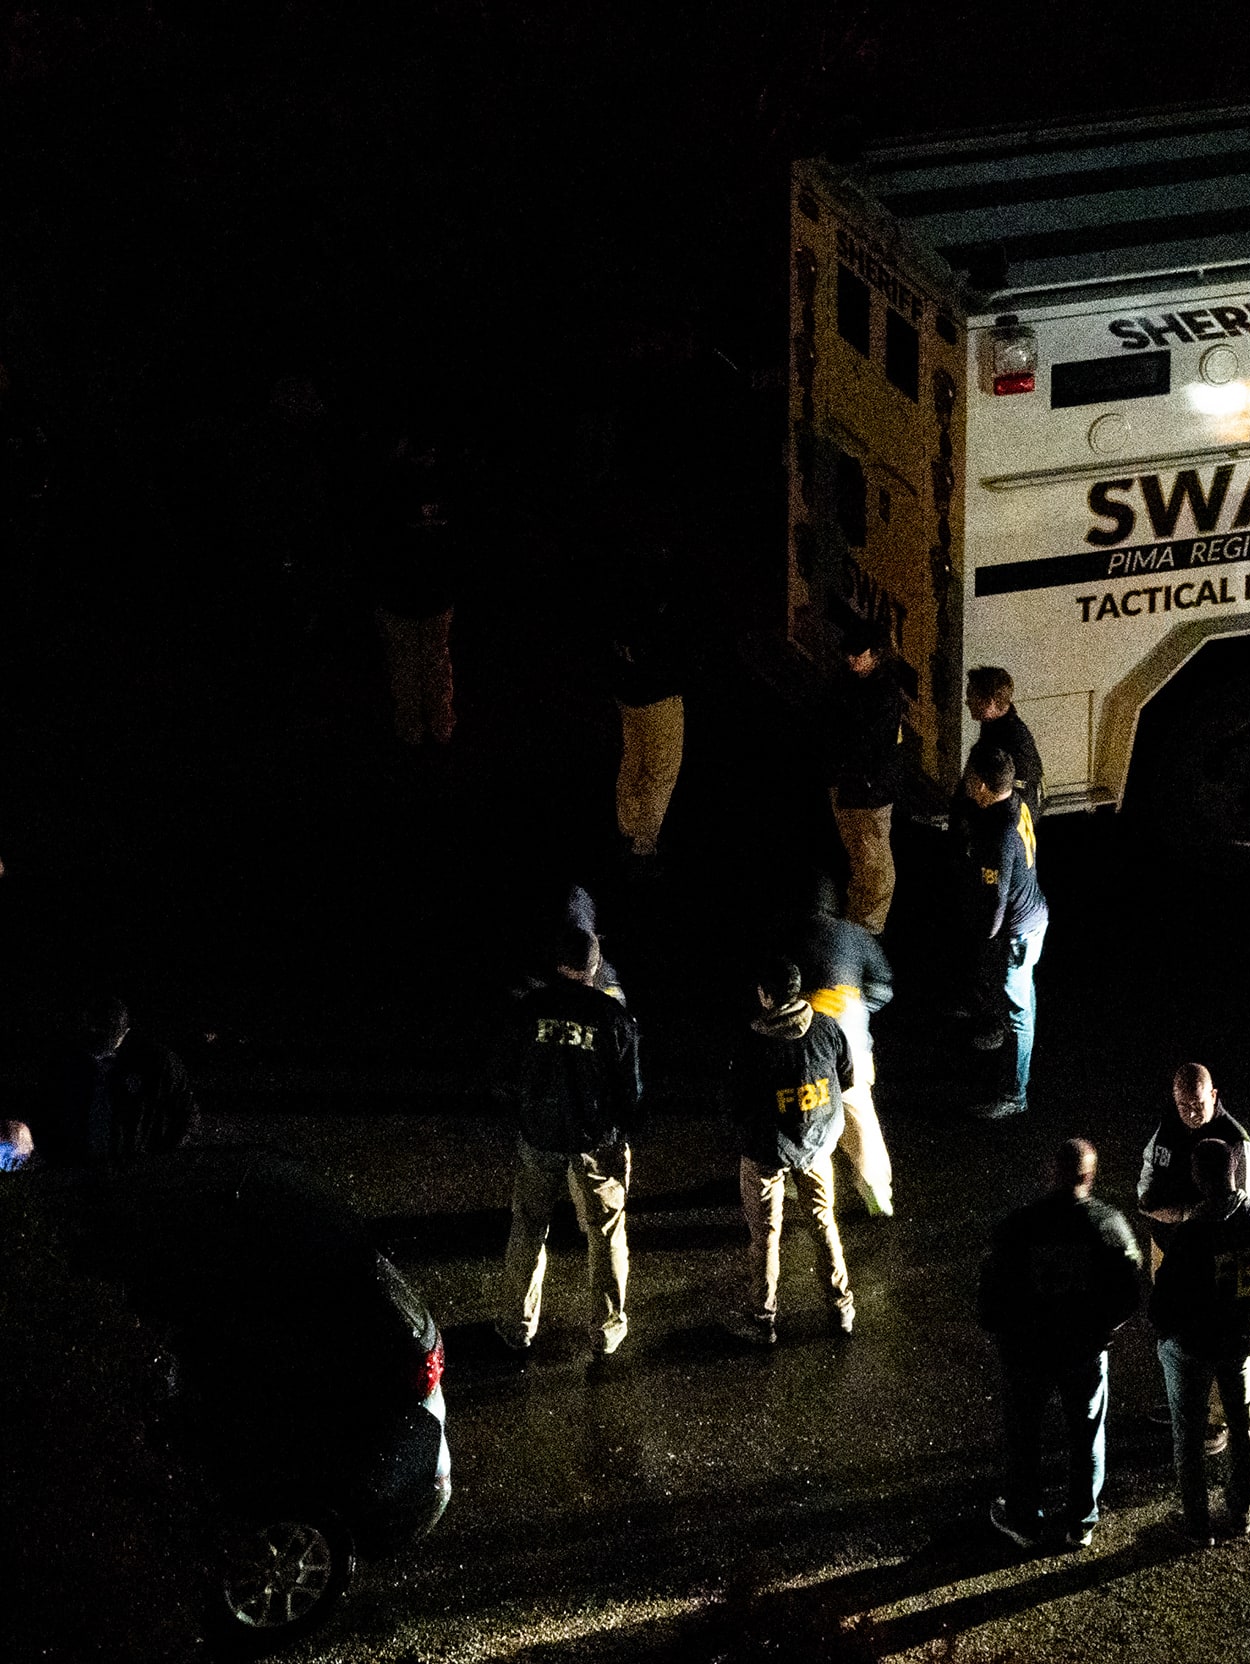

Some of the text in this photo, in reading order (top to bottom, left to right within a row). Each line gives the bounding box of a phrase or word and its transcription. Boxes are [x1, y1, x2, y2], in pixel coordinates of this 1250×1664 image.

[1107, 548, 1175, 575] PIMA
[1076, 577, 1236, 623] TACTICAL
[535, 1018, 599, 1051] FBI
[775, 1077, 830, 1115] FBI
[1153, 1144, 1173, 1168] FBI
